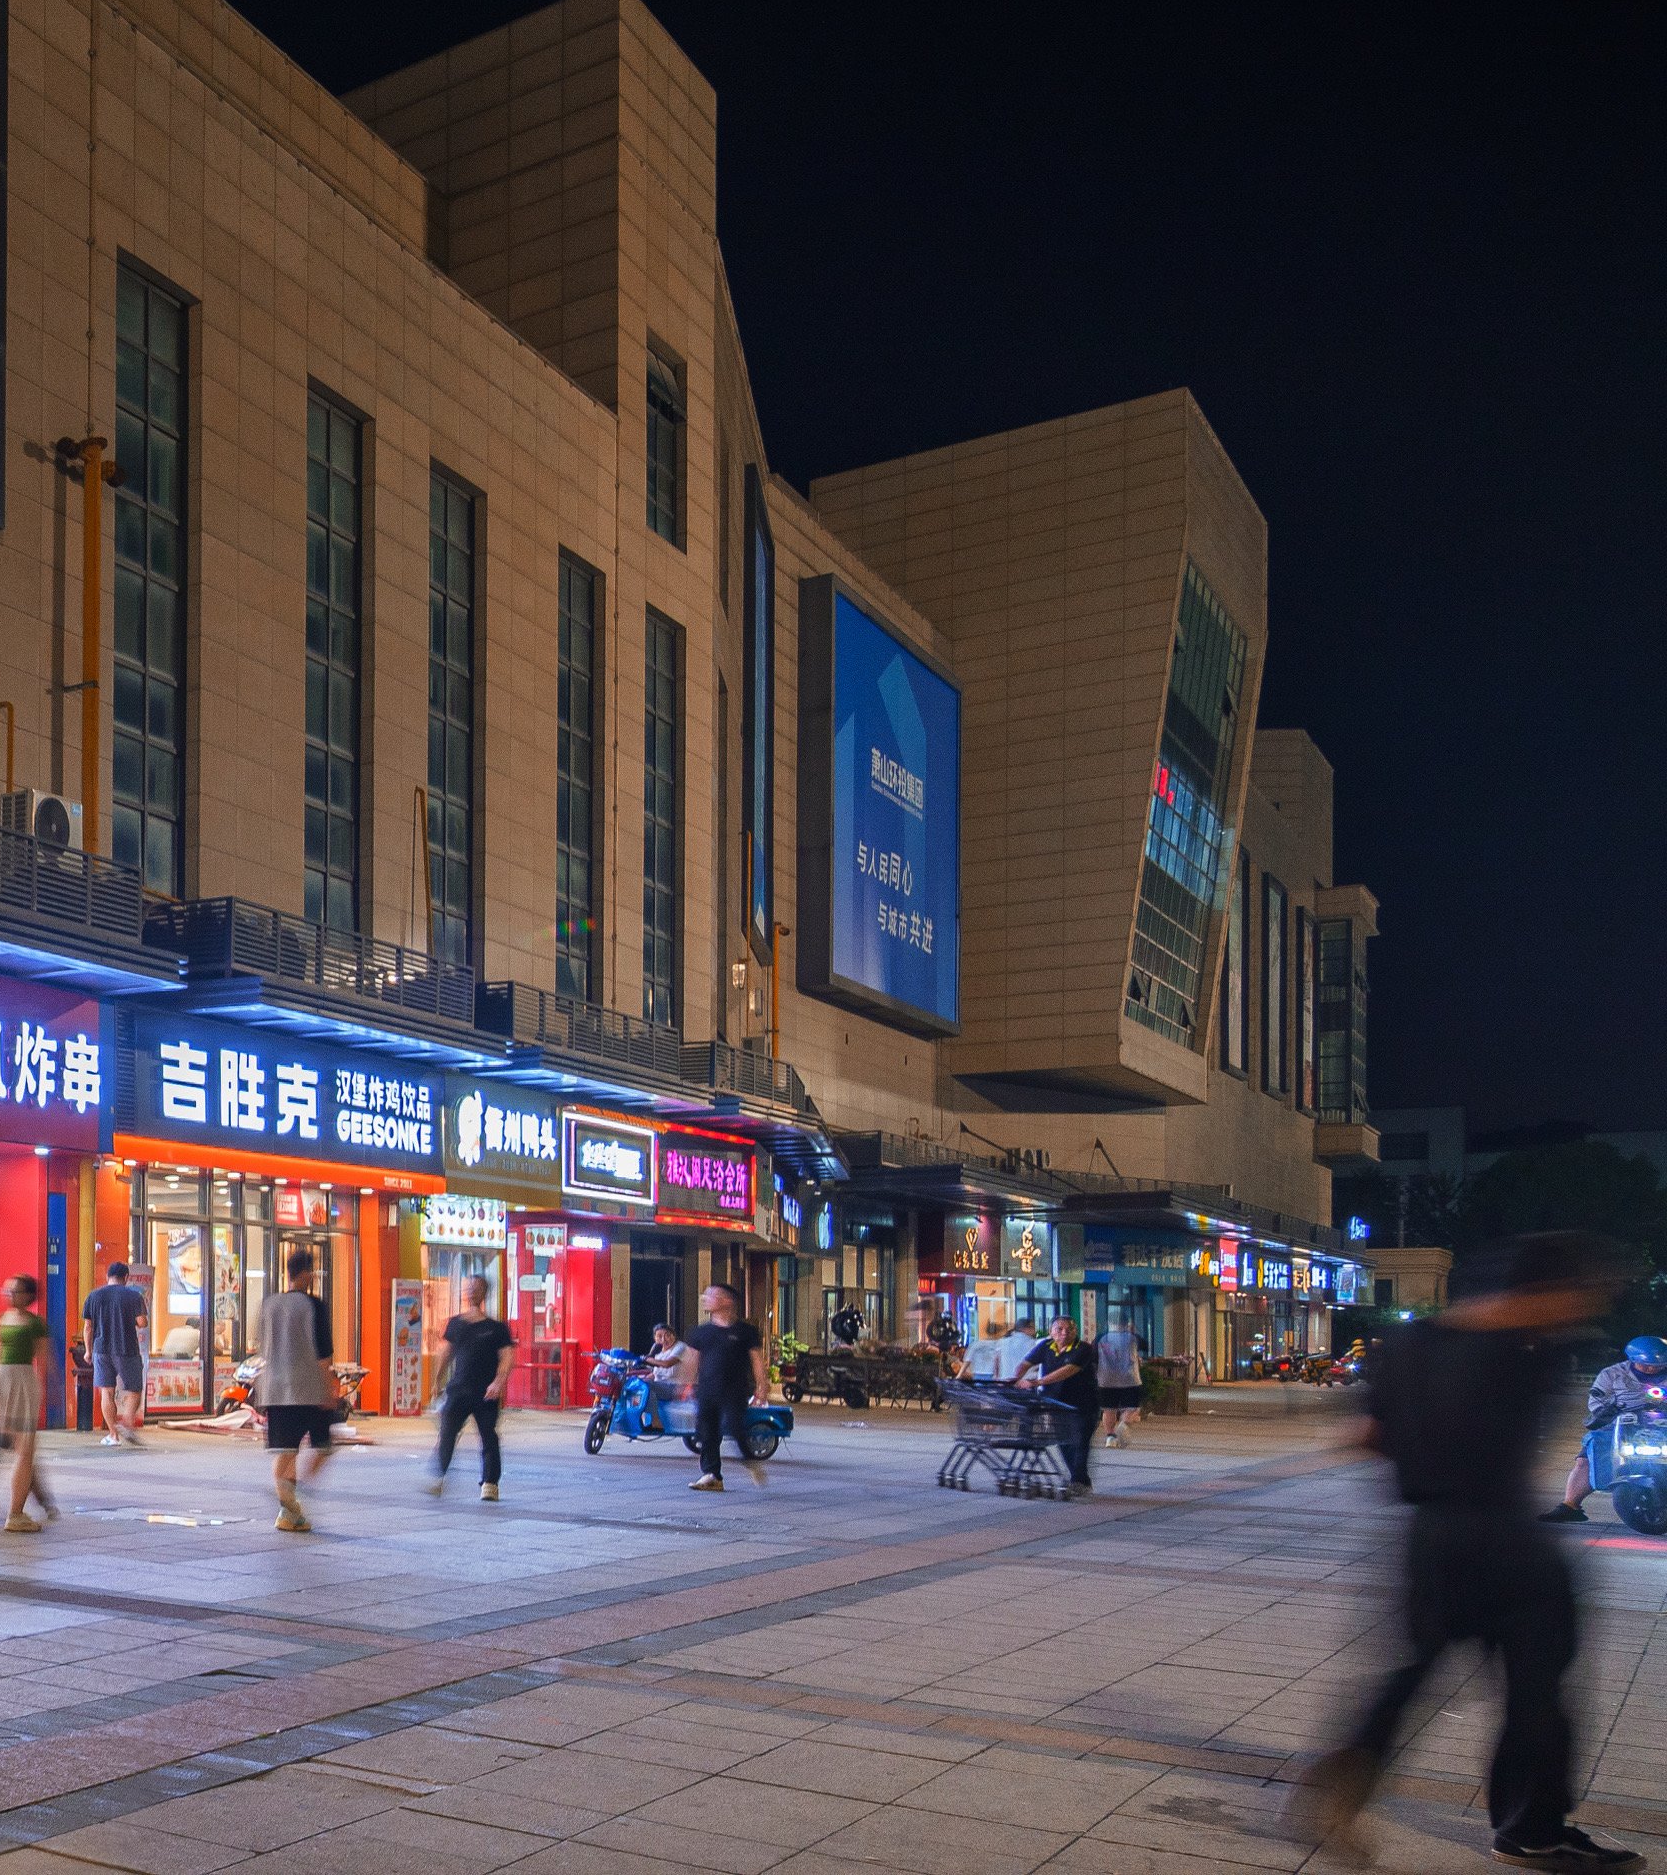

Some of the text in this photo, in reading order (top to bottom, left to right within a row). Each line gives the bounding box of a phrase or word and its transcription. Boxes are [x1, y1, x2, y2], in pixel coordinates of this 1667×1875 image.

[871, 747, 924, 810] 萧山环投集团
[857, 840, 913, 897] 与人民同心
[877, 899, 933, 954] 与城市共进
[160, 1041, 319, 1139] 吉胜克
[336, 1068, 431, 1121] 汉堡炸鸡饮品
[336, 1109, 432, 1155] GEESONKE
